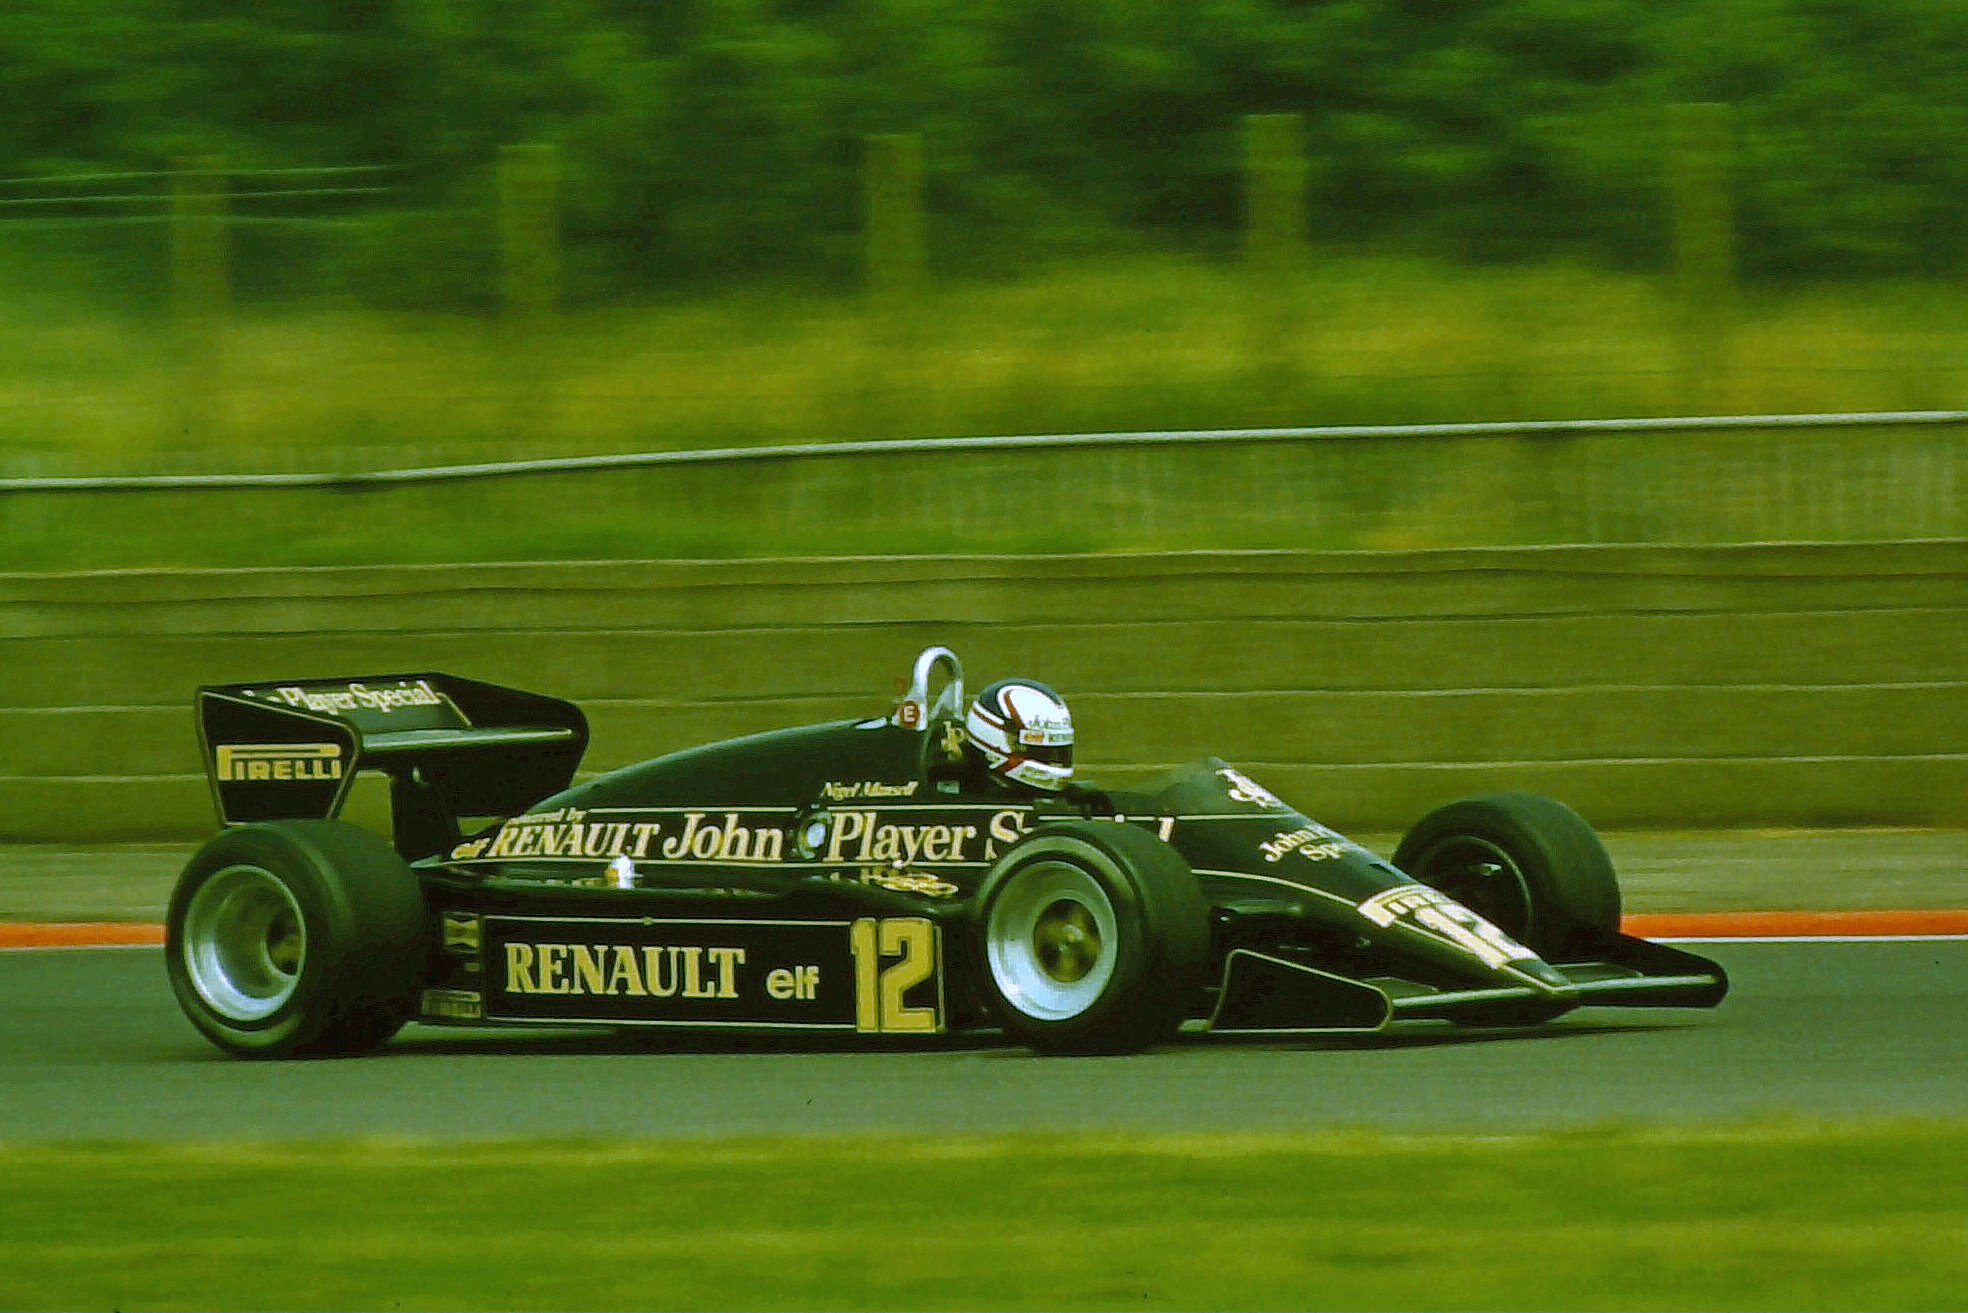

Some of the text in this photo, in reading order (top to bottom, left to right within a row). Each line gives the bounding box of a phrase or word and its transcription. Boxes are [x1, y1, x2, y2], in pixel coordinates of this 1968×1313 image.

[350, 680, 441, 713] Special
[903, 706, 914, 722] E
[216, 743, 341, 780] PIRELLI
[486, 823, 659, 858] RENAULT
[663, 812, 784, 860] John
[823, 812, 977, 868] Player
[504, 943, 819, 1000] RENAULT elf
[850, 917, 936, 1033] 12
